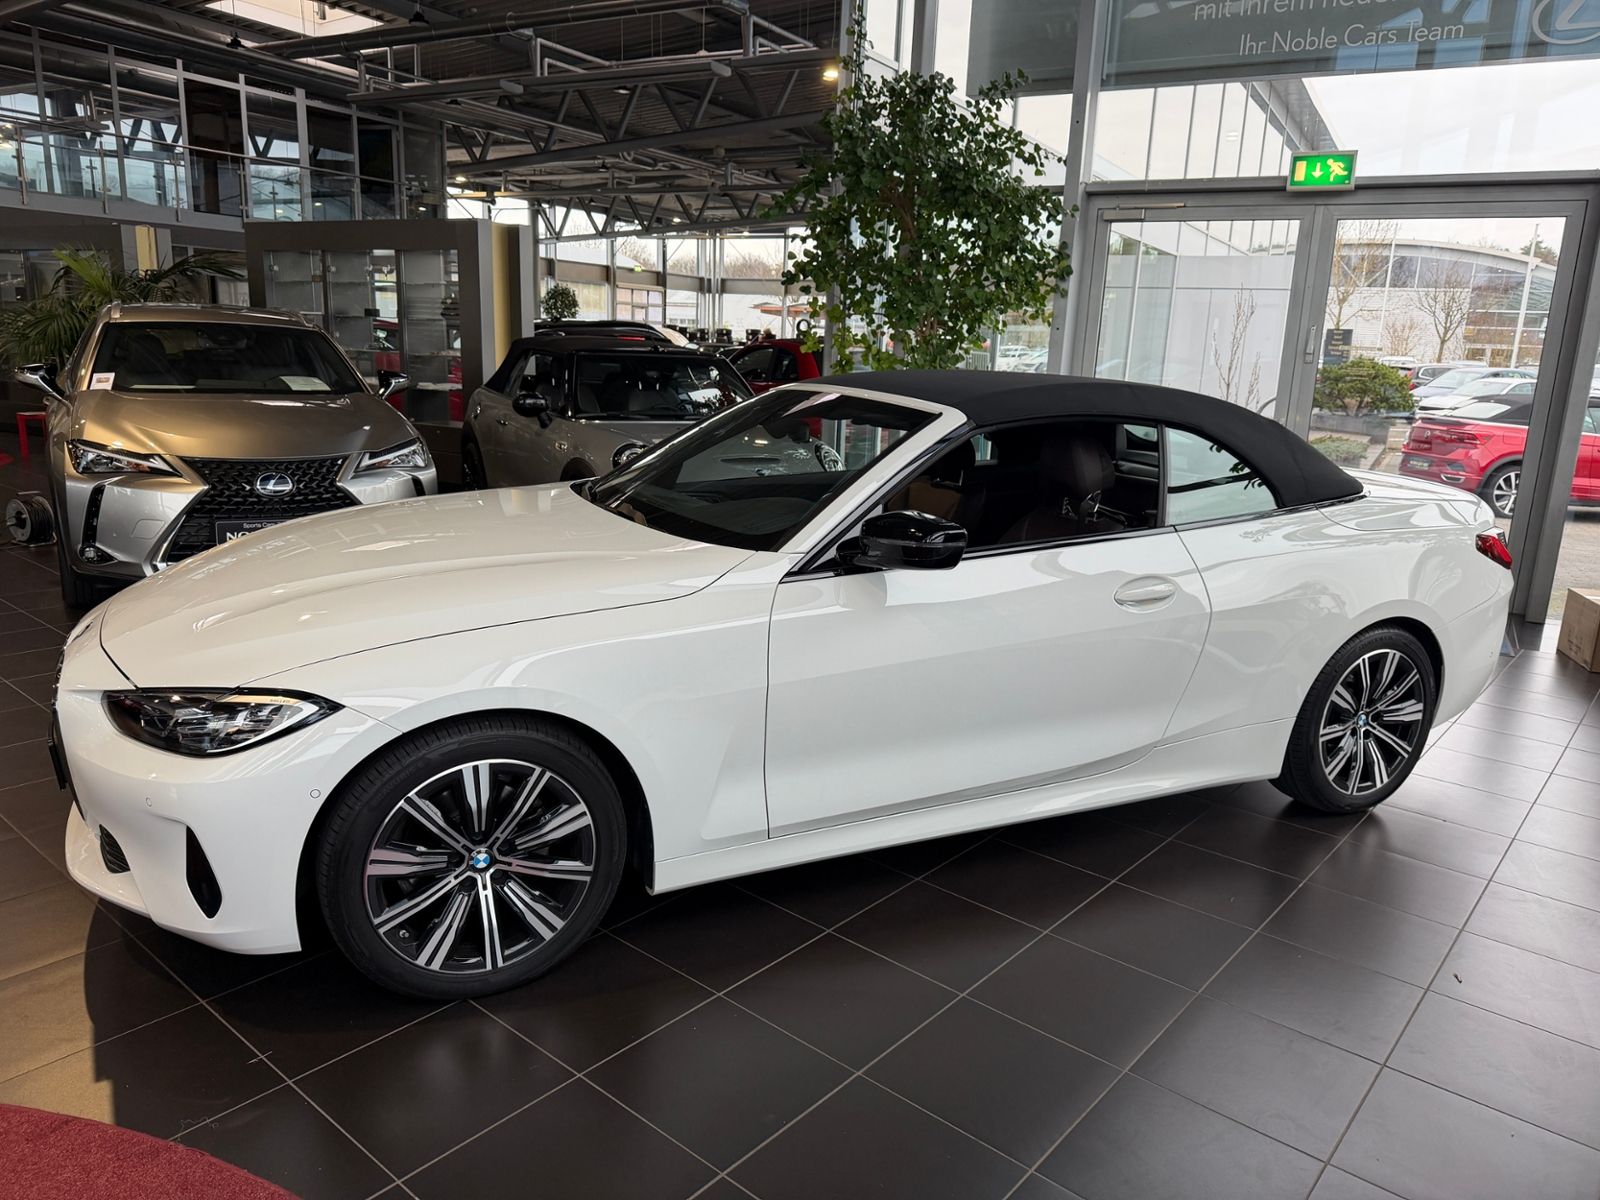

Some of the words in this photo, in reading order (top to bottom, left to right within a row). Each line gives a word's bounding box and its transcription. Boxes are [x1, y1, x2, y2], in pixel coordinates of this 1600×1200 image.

[1194, 0, 1231, 21] mit
[1239, 34, 1266, 56] Ihr
[1272, 27, 1337, 53] Noble
[1344, 24, 1397, 46] Cars
[1406, 21, 1464, 42] Team
